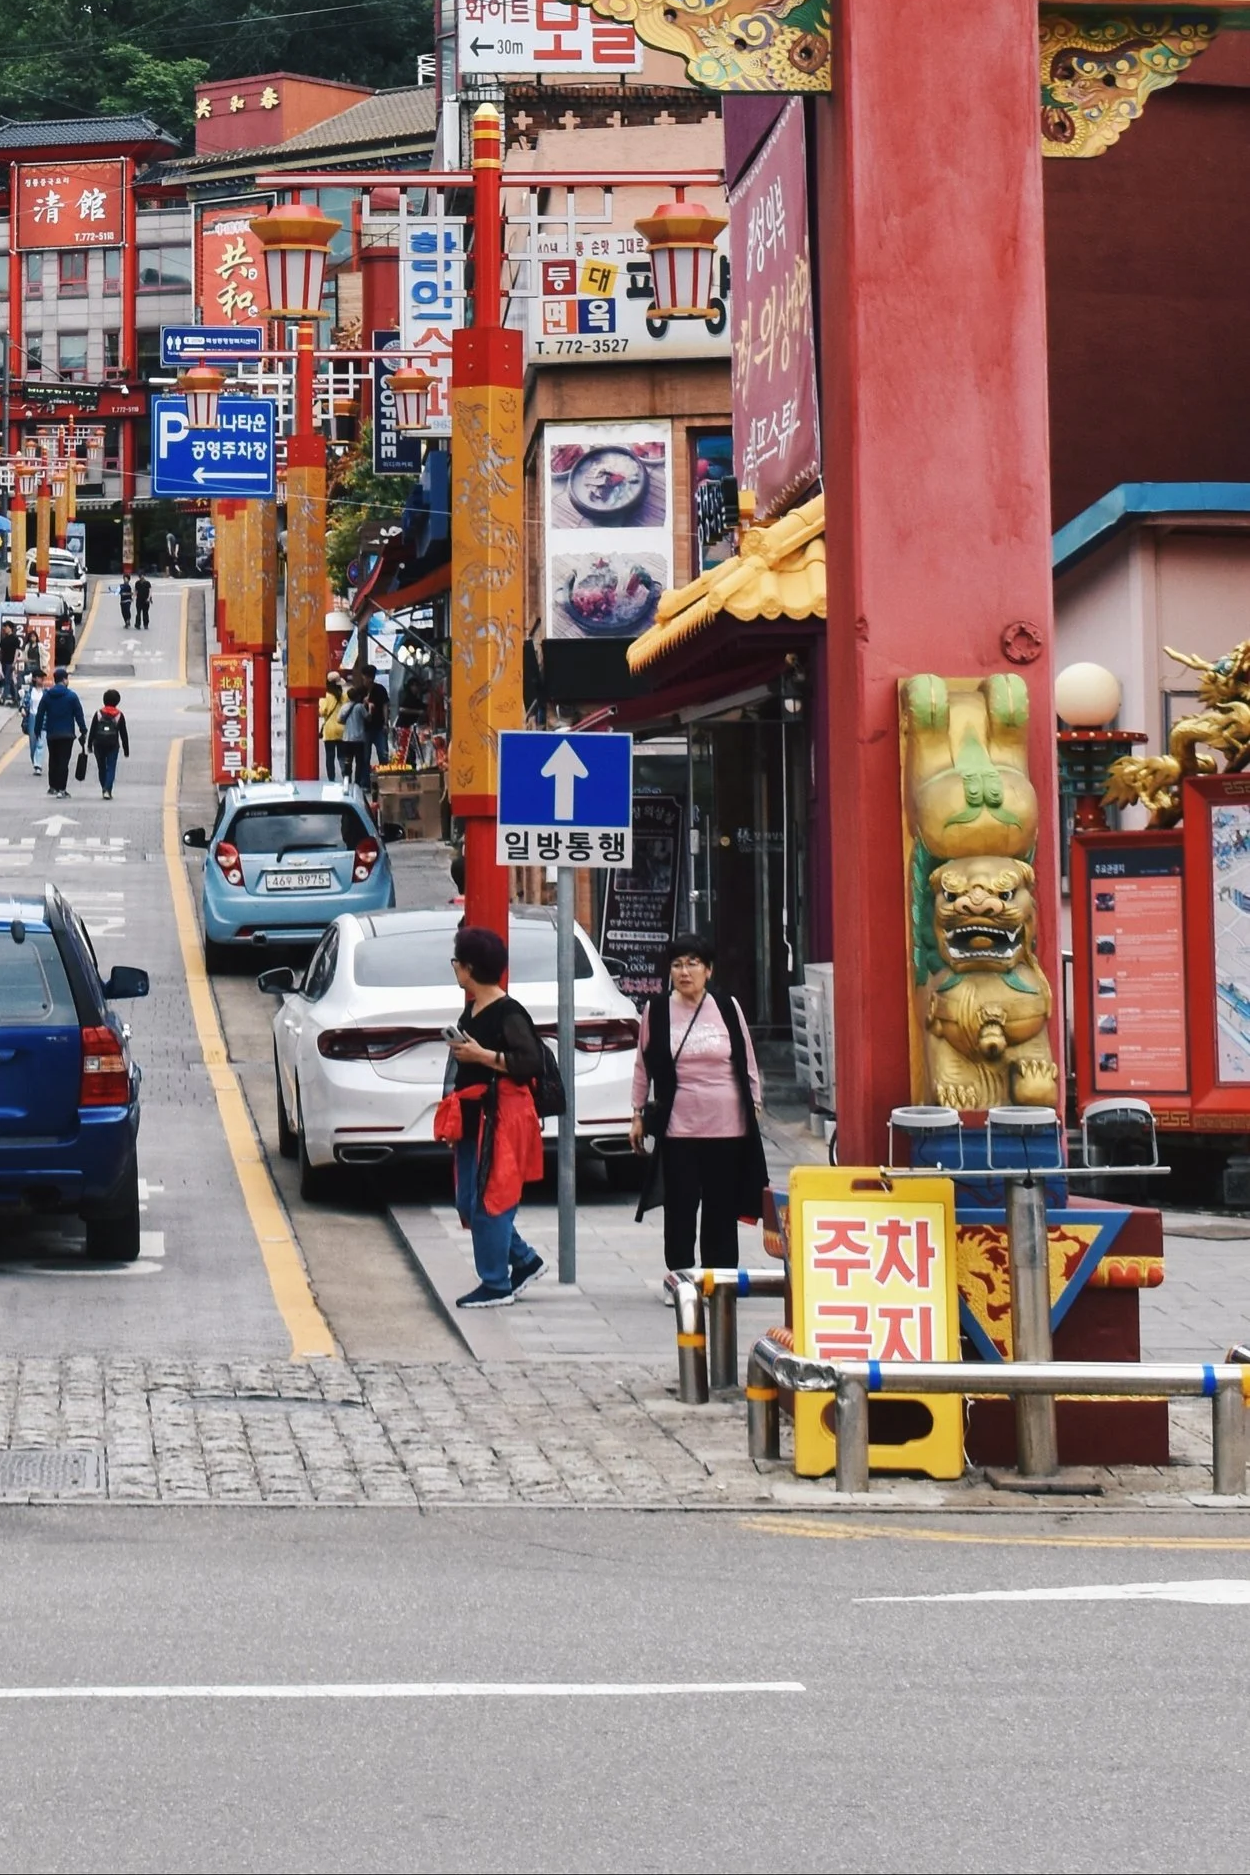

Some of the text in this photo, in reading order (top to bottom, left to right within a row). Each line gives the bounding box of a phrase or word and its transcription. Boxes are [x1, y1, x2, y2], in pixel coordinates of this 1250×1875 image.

[497, 39, 524, 55] 30m
[195, 86, 280, 119] 共和春
[591, 239, 610, 256] 손맛
[616, 237, 647, 254] 그대로
[214, 236, 254, 326] 共和
[556, 338, 630, 355] 772-3527
[379, 374, 397, 459] COFFEE
[159, 411, 190, 459] P
[191, 440, 268, 461] 공영주차장
[220, 689, 243, 778] 탕후루
[504, 832, 626, 862] 일방통행
[298, 874, 326, 886] 8975
[812, 1218, 936, 1290] 주차
[813, 1305, 934, 1362] 금지
